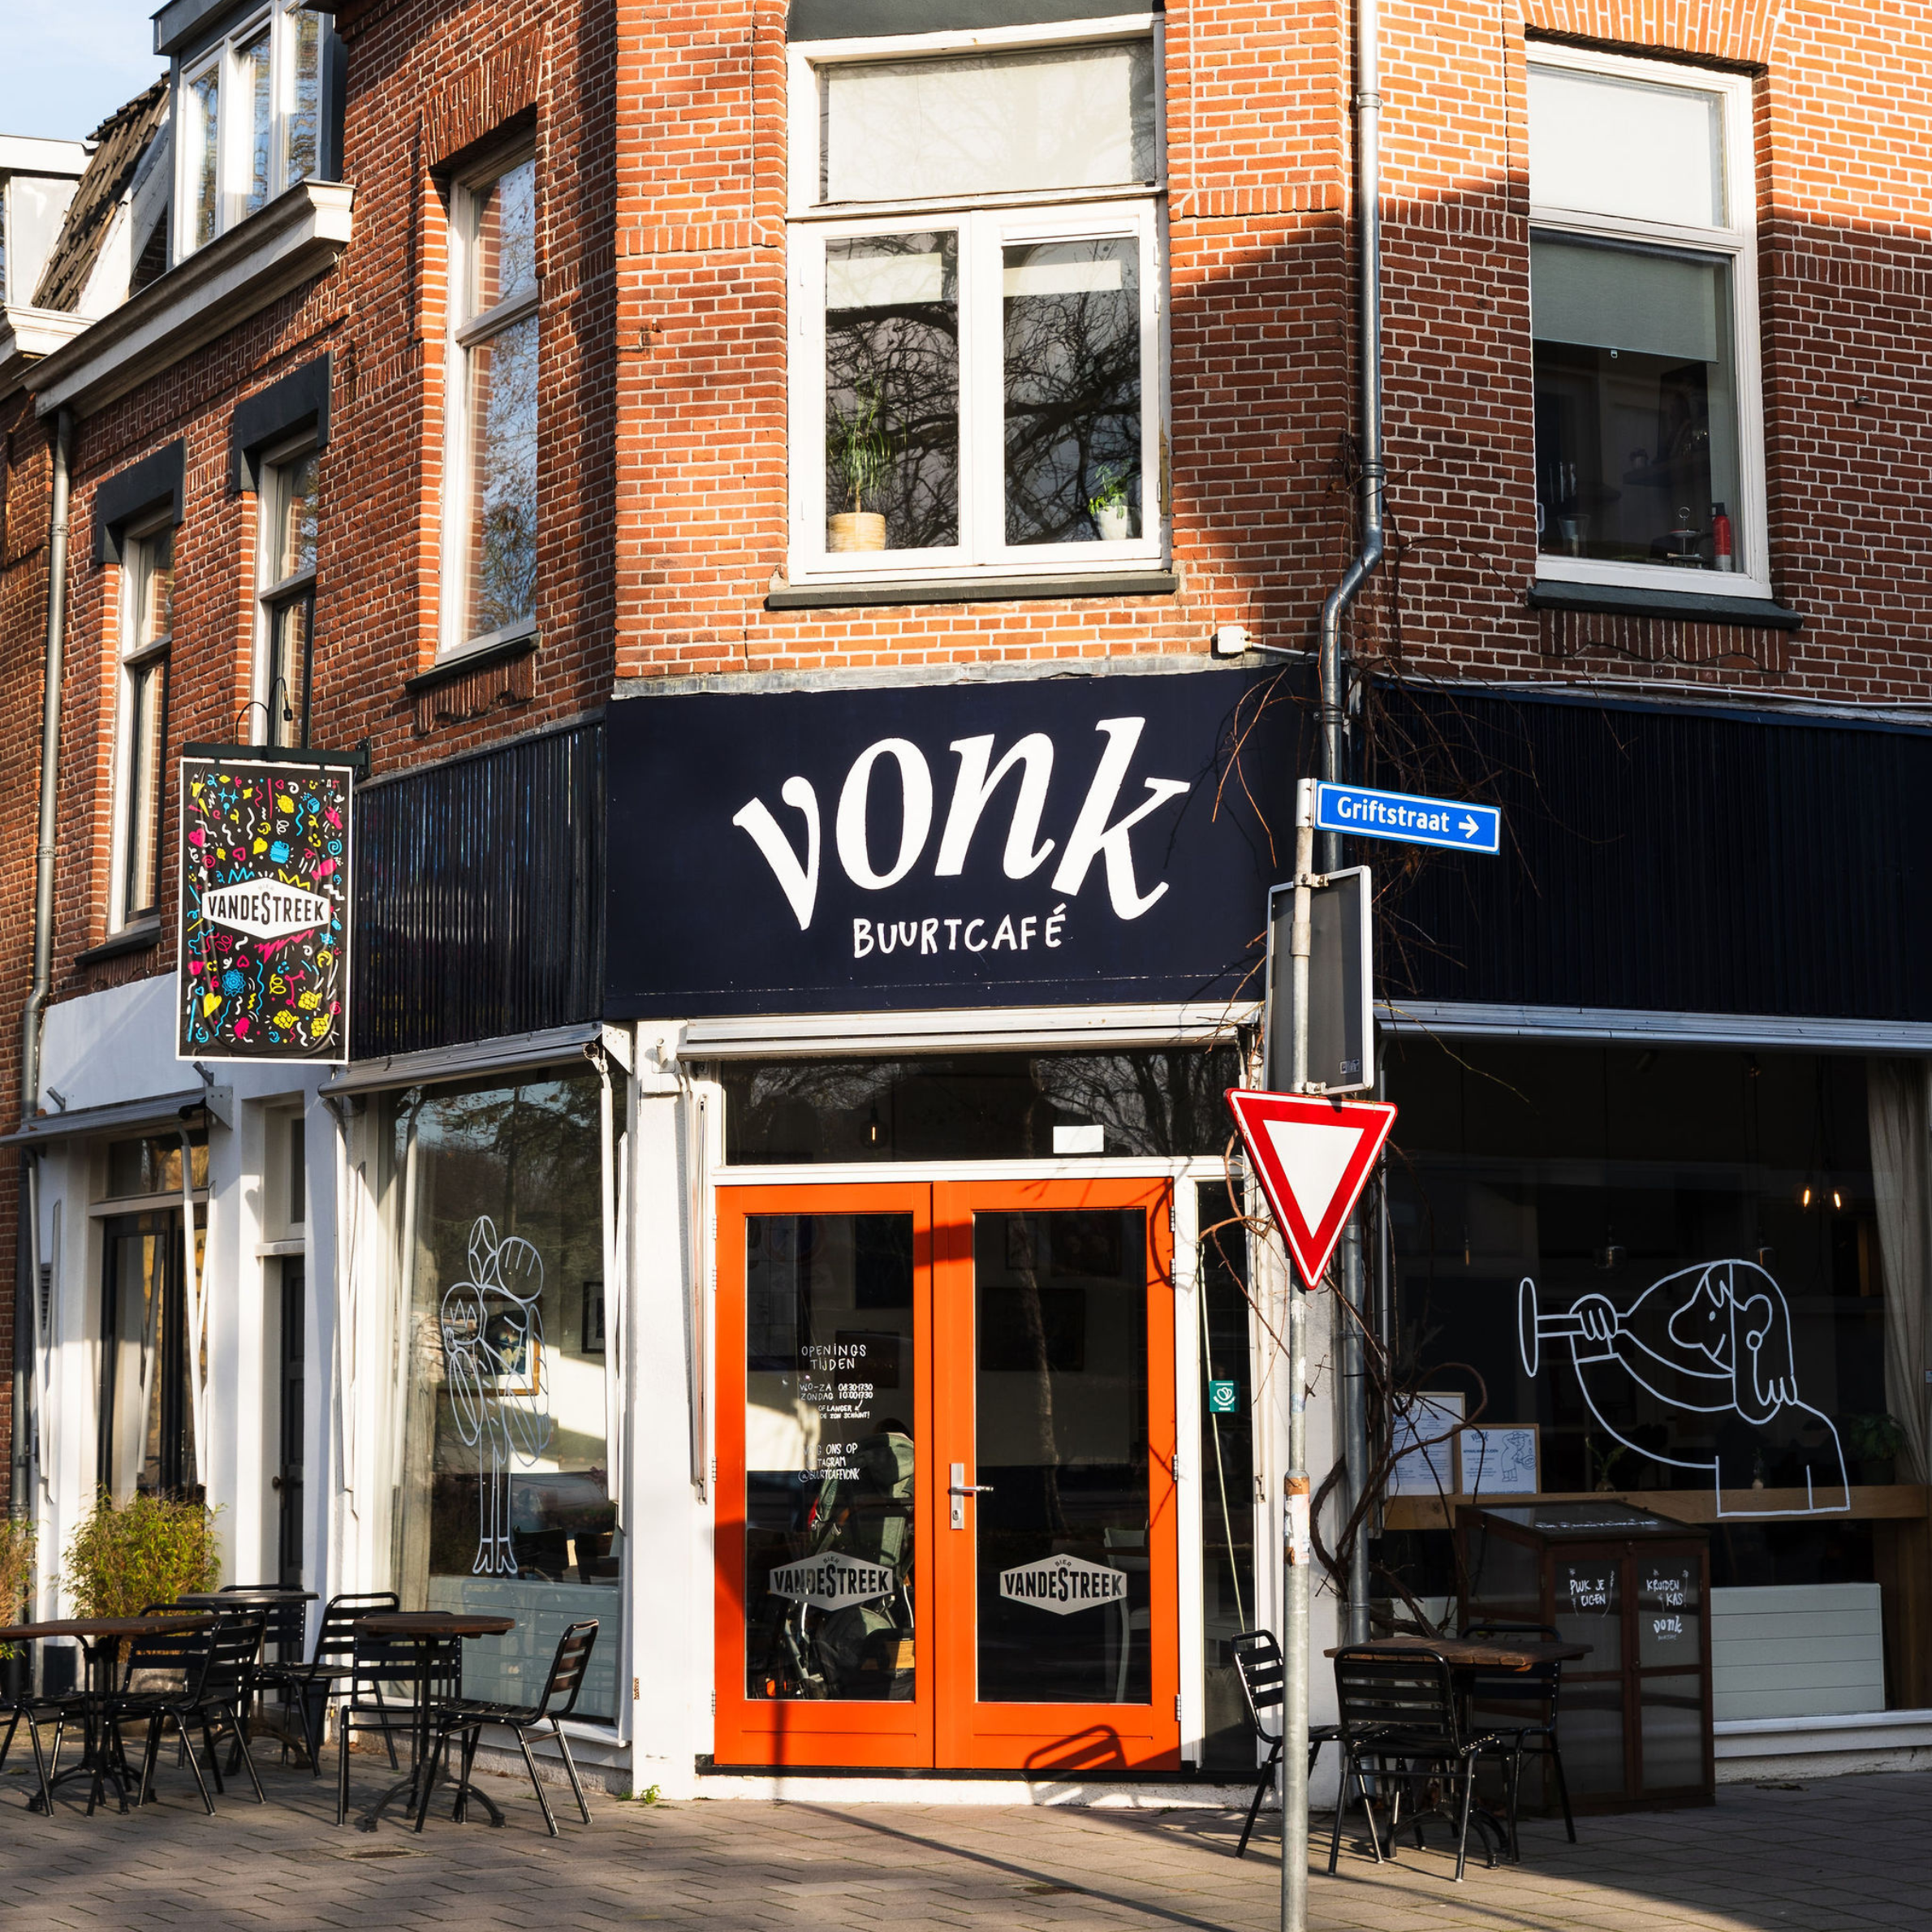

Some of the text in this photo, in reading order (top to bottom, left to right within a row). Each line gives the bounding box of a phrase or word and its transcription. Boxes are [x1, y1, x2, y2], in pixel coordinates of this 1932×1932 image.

[1337, 796, 1450, 832] Griftstraat
[732, 717, 1190, 930] vonk
[208, 891, 324, 925] VANDESTREEK
[854, 903, 1066, 959] BUURTCAFÉ
[801, 1343, 867, 1357] OPENINGS
[810, 1356, 855, 1371] TIJDEN
[800, 1391, 834, 1400] ZONDAG
[826, 1404, 852, 1412] LANGER
[826, 1443, 842, 1455] ONS
[846, 1443, 858, 1454] OP
[814, 1456, 847, 1468] TAGRAM
[1054, 1559, 1072, 1568] BIER
[774, 1563, 889, 1598] VANDESTREEK
[1004, 1567, 1123, 1602] VANDESTREEK
[1595, 1579, 1605, 1591] JE
[1666, 1592, 1684, 1606] KAS
